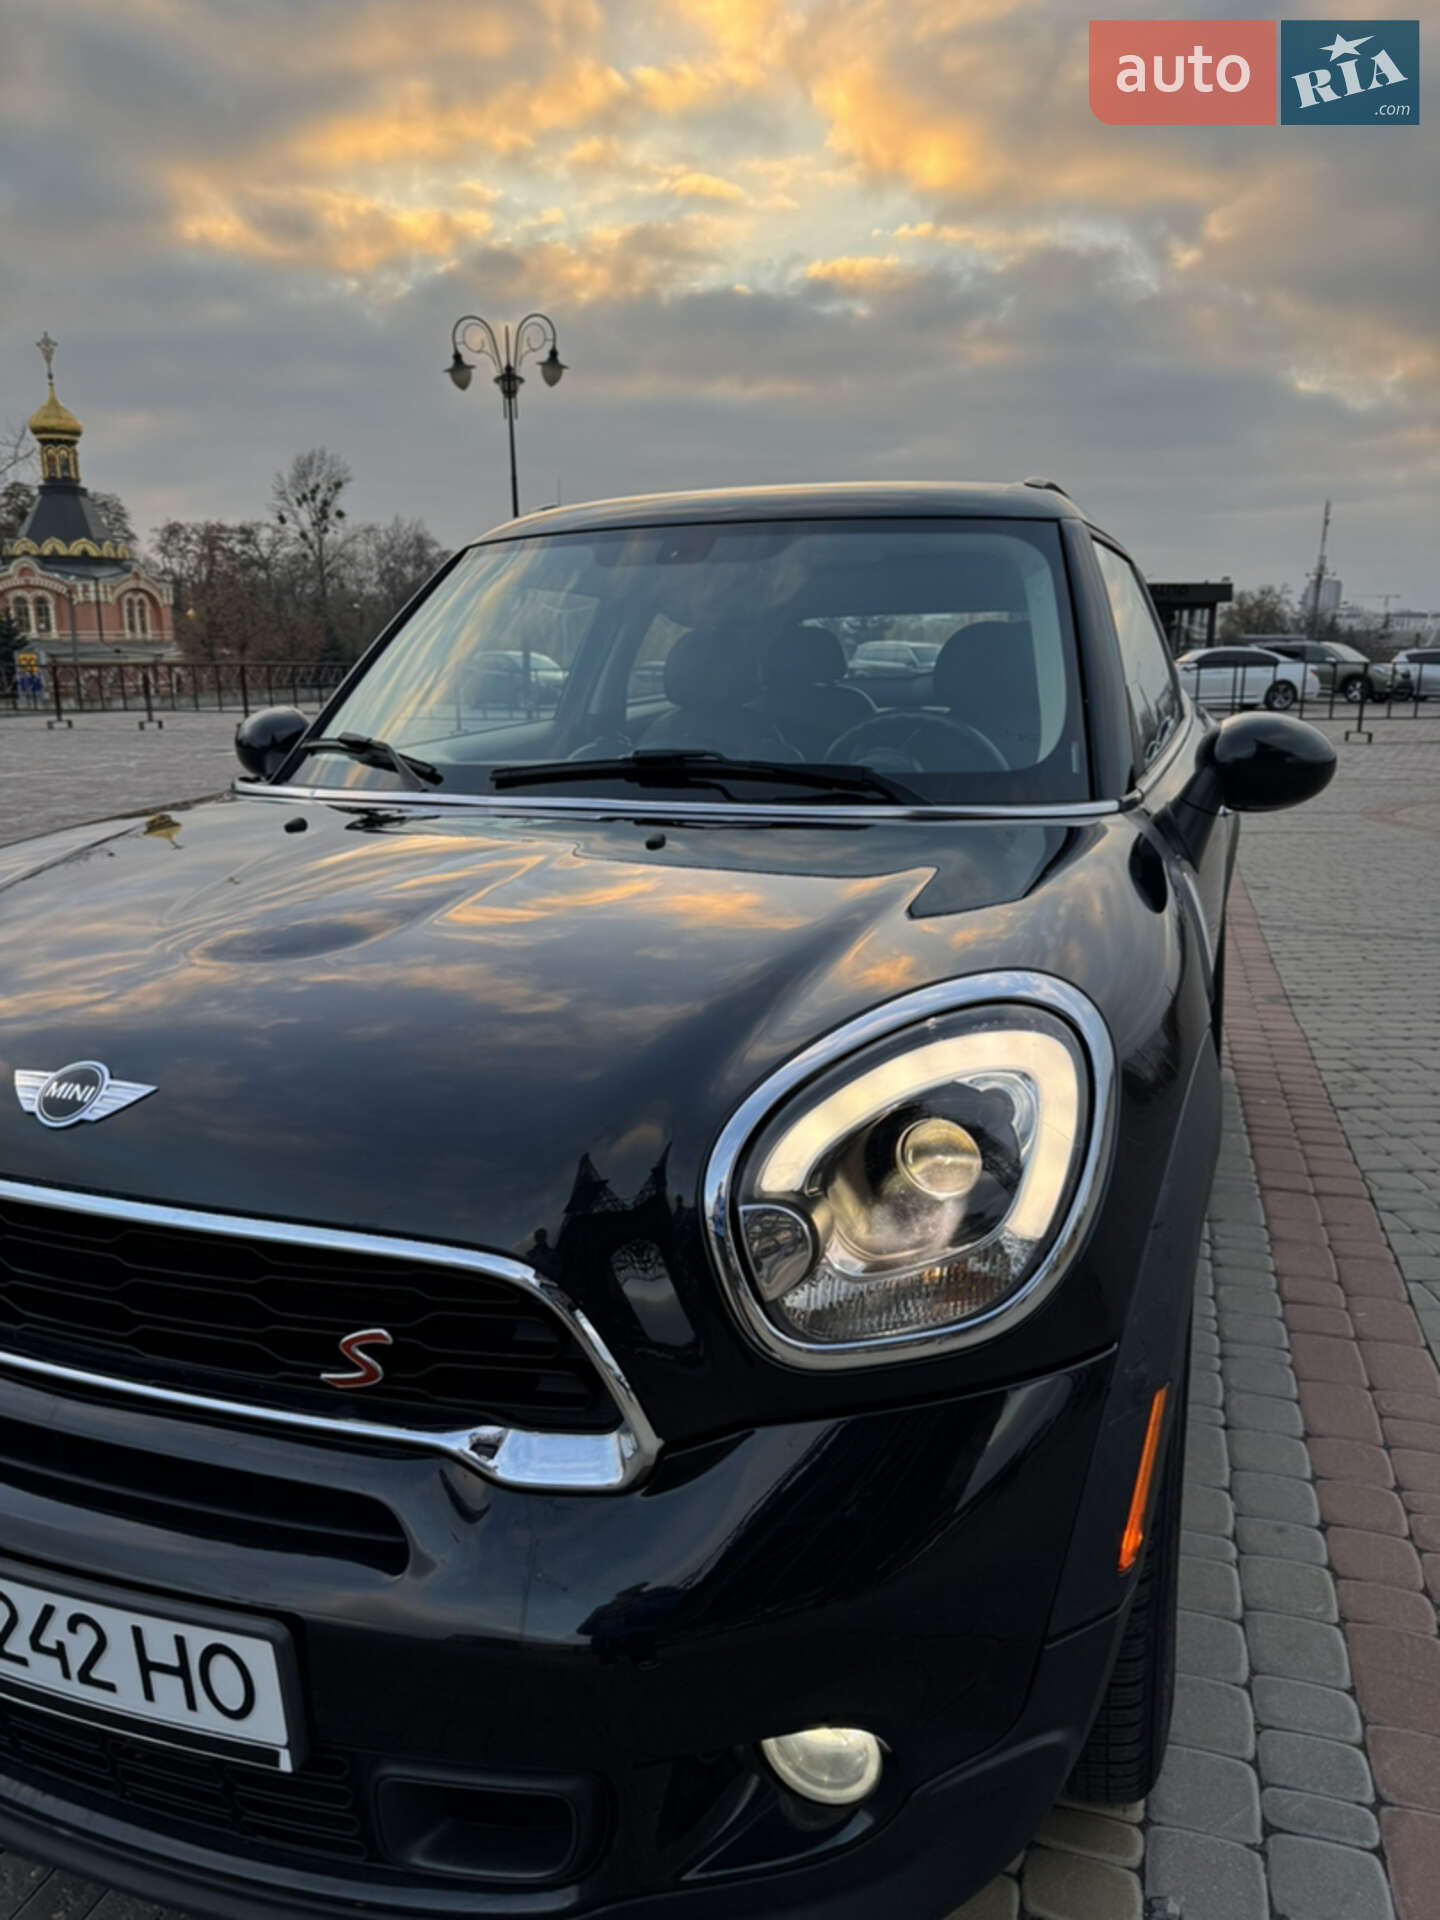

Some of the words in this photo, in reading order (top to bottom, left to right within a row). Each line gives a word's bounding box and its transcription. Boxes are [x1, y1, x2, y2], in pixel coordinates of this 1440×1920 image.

[45, 1081, 95, 1103] MINI
[320, 1328, 394, 1388] S
[131, 1624, 256, 1721] HO
